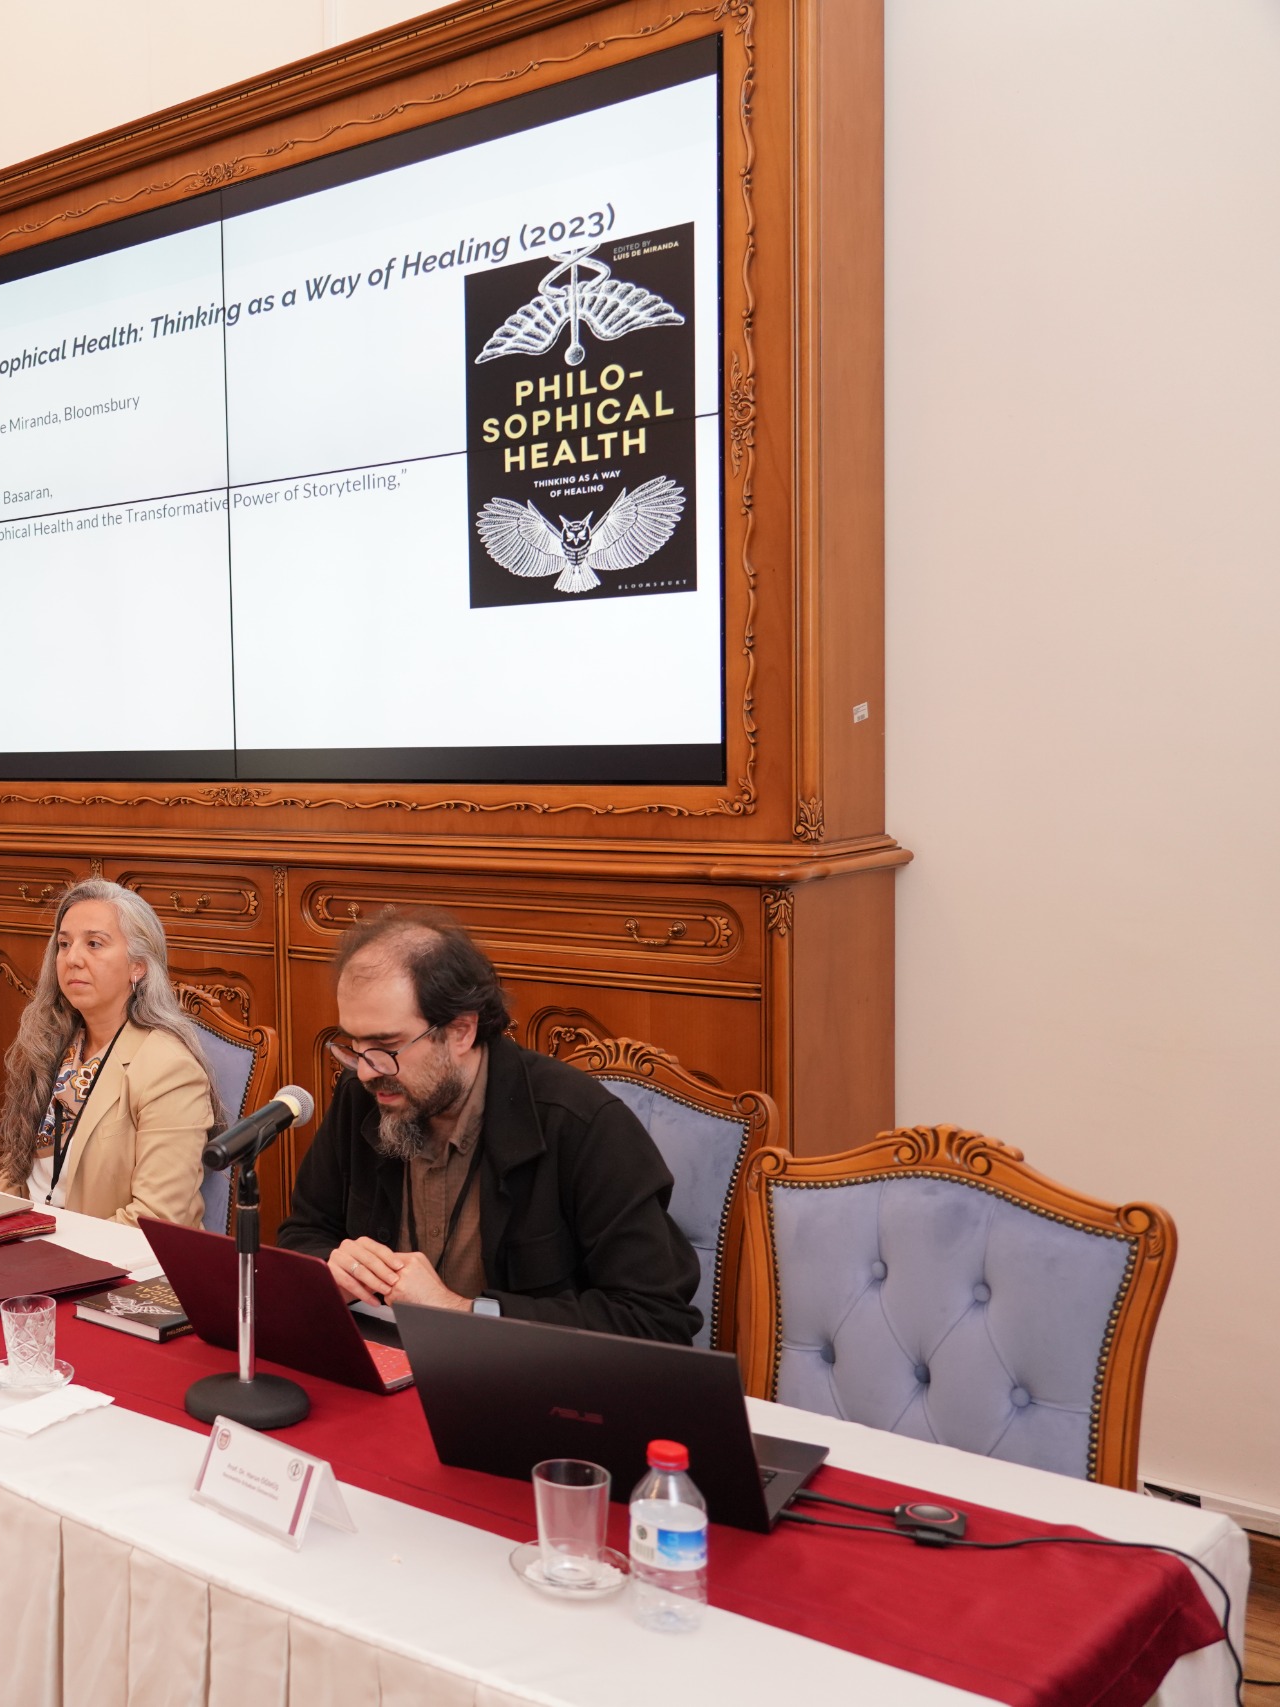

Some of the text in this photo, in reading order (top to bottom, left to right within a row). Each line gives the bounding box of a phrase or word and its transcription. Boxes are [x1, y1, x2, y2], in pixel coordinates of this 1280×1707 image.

[613, 240, 651, 254] EDITED BY
[613, 241, 679, 261] LUIS DE MIRANDA
[72, 323, 144, 358] Health:
[150, 302, 241, 339] Thinking
[247, 294, 275, 315] as
[281, 289, 297, 307] a
[305, 273, 361, 302] Way
[367, 257, 397, 290] of
[401, 235, 511, 280] Healing
[519, 202, 616, 251] (2023)
[515, 364, 643, 407] PHILO-
[9, 411, 62, 433] Miranda,
[64, 395, 140, 421] Bloomsbury
[482, 390, 674, 443] SOPHICAL
[504, 427, 646, 473] HEALTH
[3, 487, 53, 505] Basaran,
[534, 476, 576, 488] THINKING
[578, 474, 590, 483] AS
[601, 469, 621, 479] WAY
[550, 484, 604, 498] OF HEALING
[33, 518, 73, 536] Health
[76, 514, 99, 530] and
[102, 512, 122, 527] the
[125, 497, 228, 523] Transformative
[233, 491, 280, 508] Power
[284, 484, 299, 502] of
